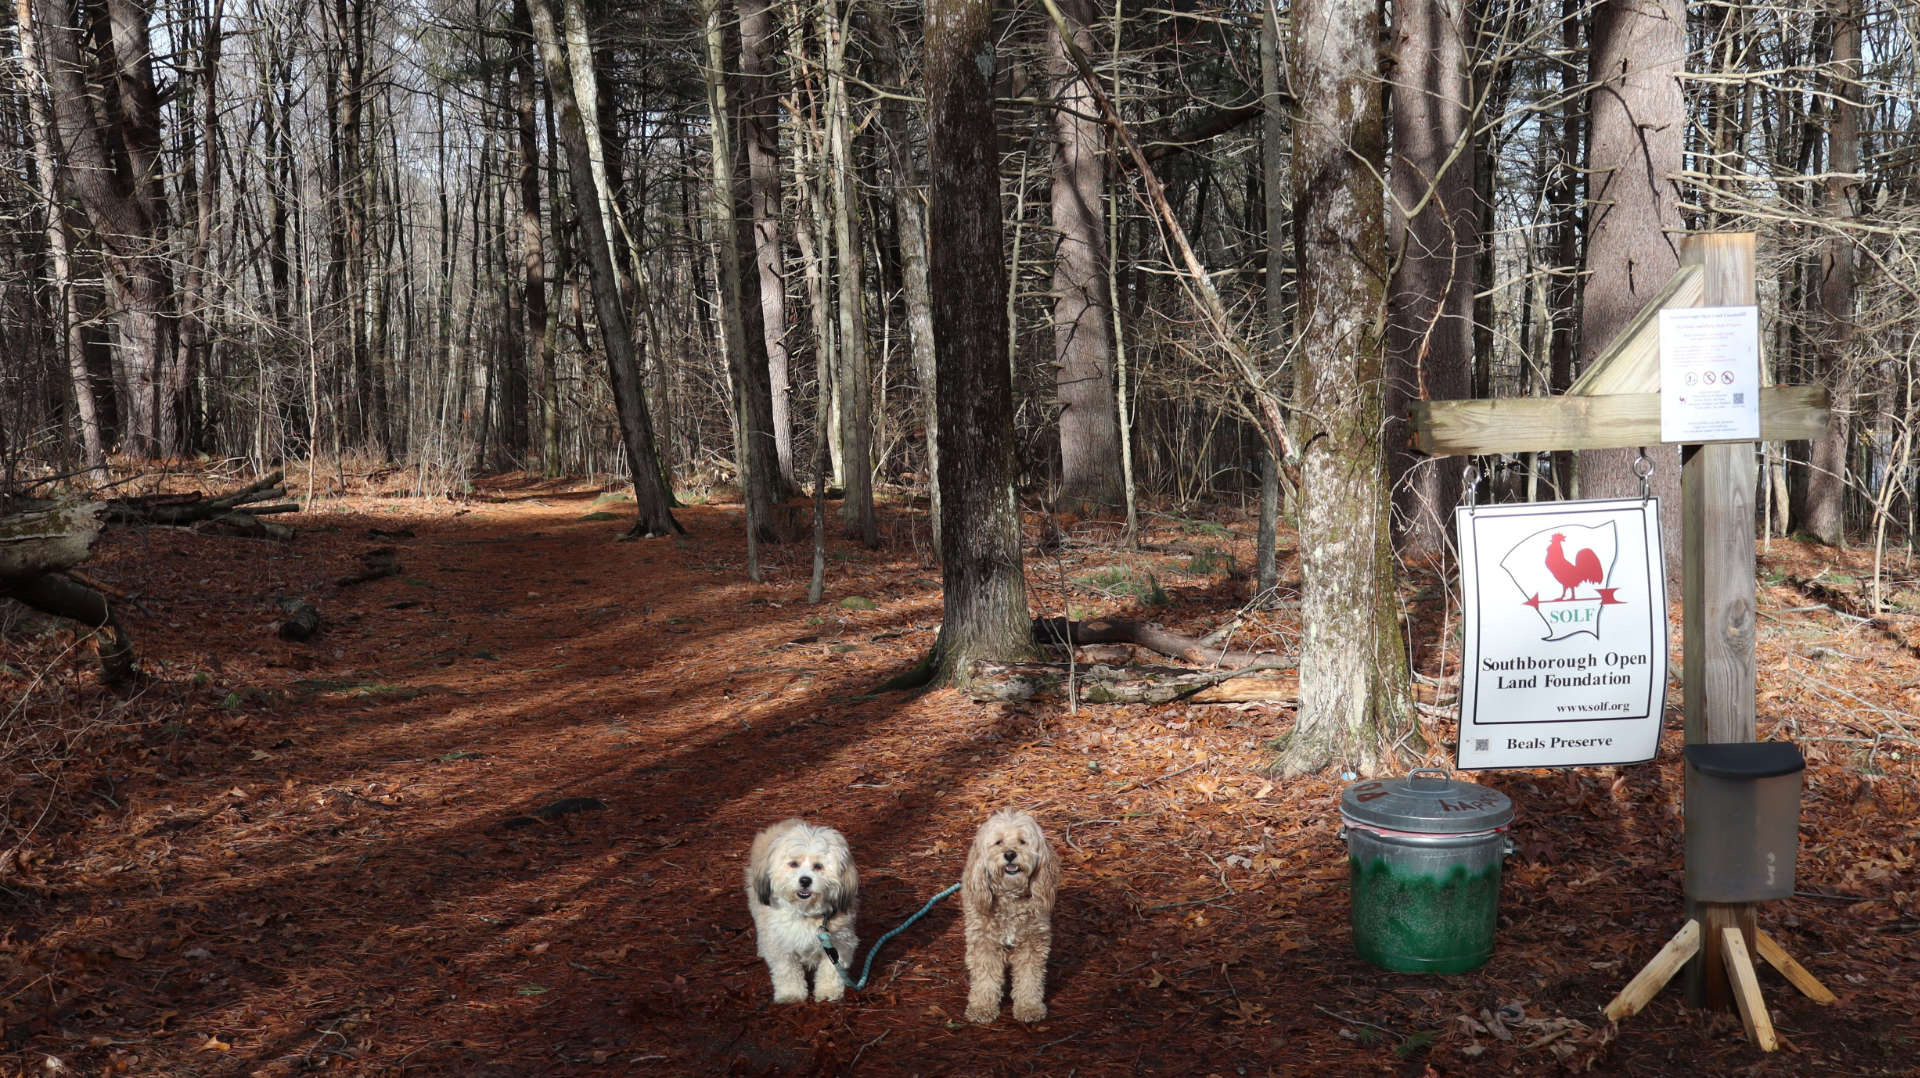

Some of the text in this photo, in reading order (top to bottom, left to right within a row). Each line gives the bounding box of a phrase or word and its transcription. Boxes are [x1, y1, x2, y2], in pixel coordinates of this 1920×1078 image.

[1550, 609, 1595, 623] SOLF
[1482, 651, 1647, 671] Southborough Open
[1497, 672, 1631, 690] Land Foundation
[1556, 701, 1630, 712] www.solf.org
[1507, 736, 1613, 750] Beals Preserve
